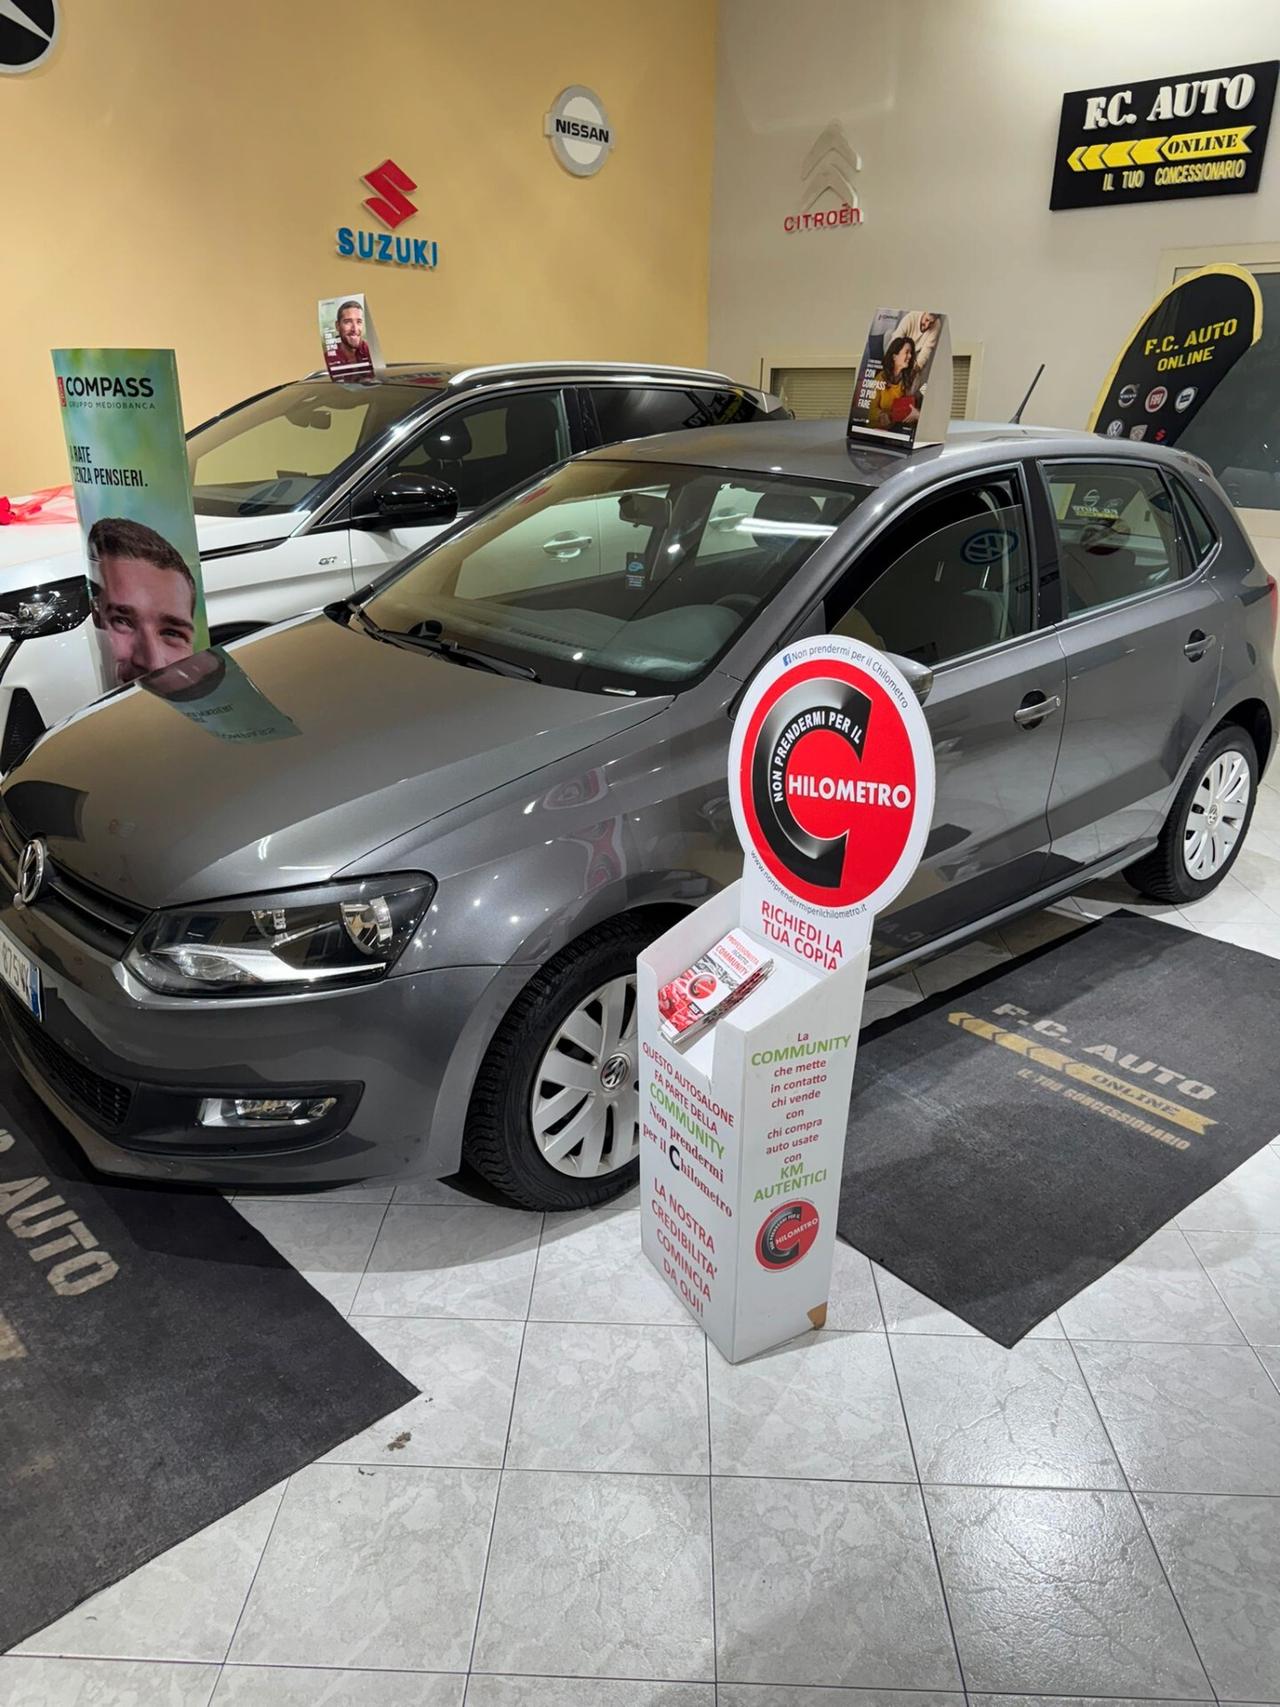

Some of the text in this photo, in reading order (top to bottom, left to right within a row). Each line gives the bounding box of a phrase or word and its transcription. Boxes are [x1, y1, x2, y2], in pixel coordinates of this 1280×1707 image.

[1083, 73, 1255, 130] F.C. AUTO
[555, 118, 609, 143] NISSAN
[1168, 133, 1238, 155] ONLINE
[1102, 159, 1246, 191] IL TUO CONCESSIONARIO
[336, 227, 438, 268] SUZUKI
[1144, 318, 1238, 355] F.C. AUTO
[1157, 346, 1215, 372] ONLINE
[66, 377, 154, 398] COMPASS
[95, 401, 156, 410] MEDIOBANCA
[94, 468, 149, 487] PENSIERI.
[791, 643, 909, 709] Non prendermi per il Chilometro
[773, 710, 863, 803] NON PRENDERMI PER IL
[761, 900, 844, 958] RICHIEDI LA
[762, 919, 838, 971] TUA COPIA
[751, 1035, 851, 1066] COMMUNITY
[797, 1032, 809, 1043] La
[992, 1003, 1217, 1100] F.C. AUTO
[642, 1041, 735, 1127] QUESTO AUTOSALONE
[771, 1073, 827, 1094] in contatto
[774, 1059, 827, 1078] che mette
[1033, 1074, 1064, 1092] TUO
[654, 1070, 718, 1135] FA PARTE DELLA
[771, 1089, 821, 1109] chi vende
[1091, 1074, 1182, 1117] ONLINE
[650, 1082, 725, 1160] COMMUNITY
[767, 1118, 823, 1140] chi compra
[786, 1109, 805, 1120] con
[643, 1123, 659, 1146] per
[659, 1136, 667, 1154] il
[650, 1102, 724, 1184] Non prendermi
[766, 1133, 819, 1155] auto usate
[780, 1162, 804, 1180] KM
[784, 1153, 802, 1165] con
[753, 1169, 827, 1203] AUTENTICI
[654, 1177, 715, 1254] LA NOSTRA
[0, 1175, 120, 1296] AUTO
[651, 1199, 718, 1280] CREDIBILITA'
[656, 1228, 712, 1301] COMINCIA
[664, 1258, 678, 1286] DA
